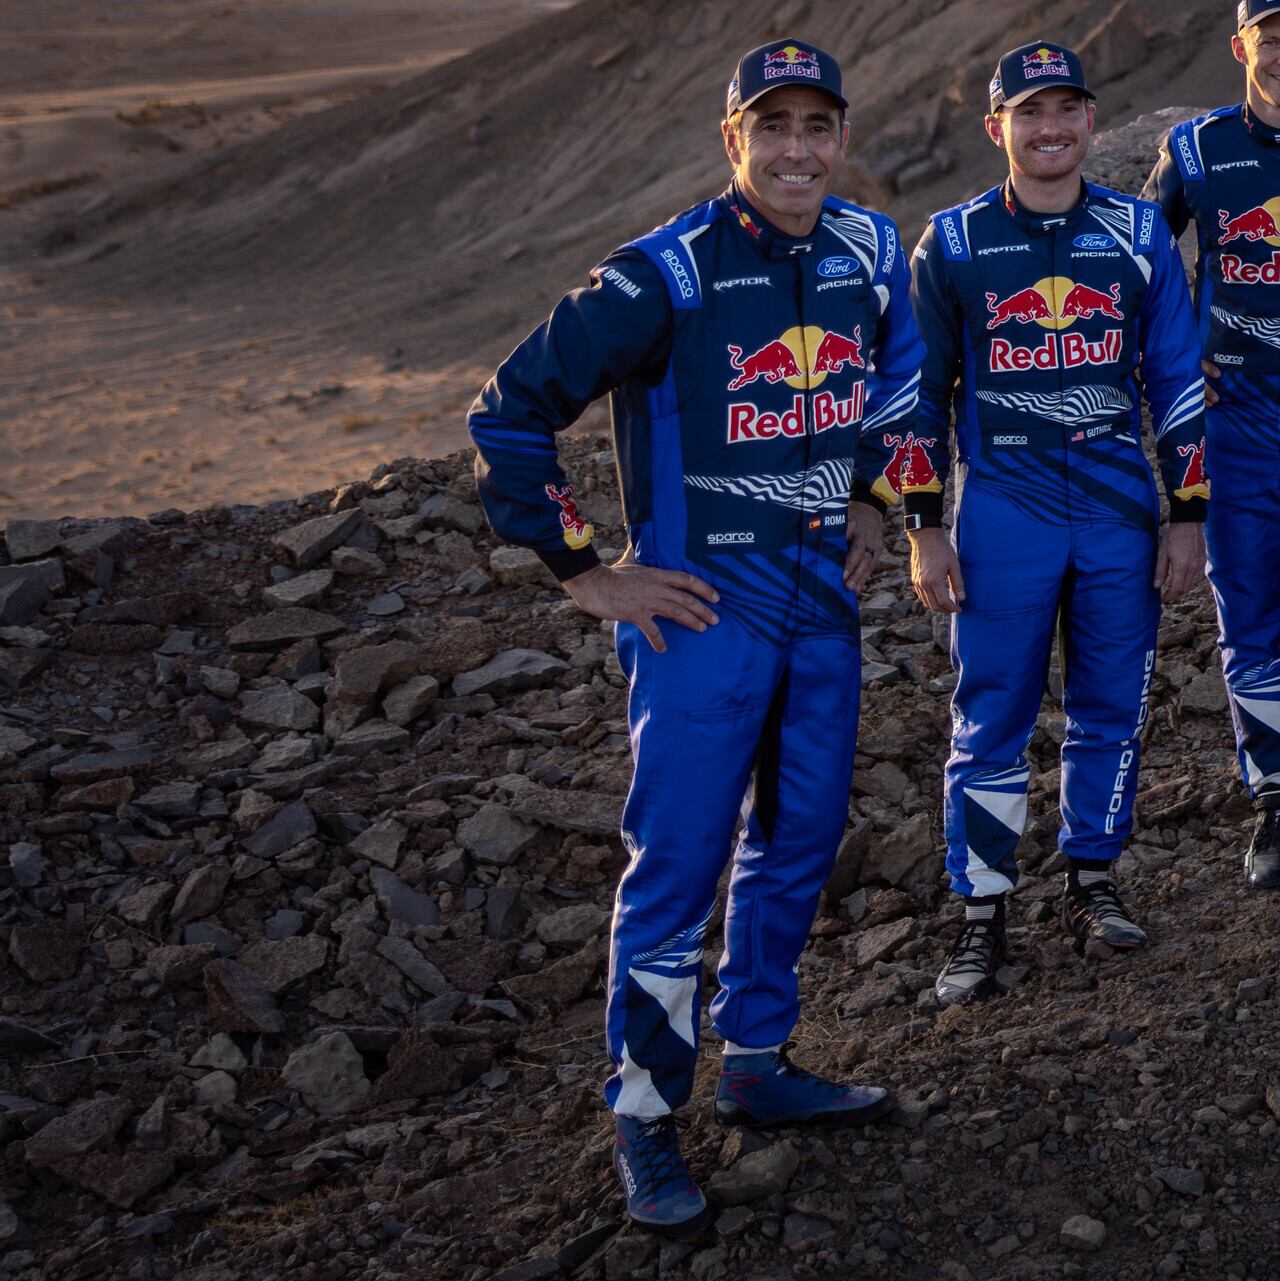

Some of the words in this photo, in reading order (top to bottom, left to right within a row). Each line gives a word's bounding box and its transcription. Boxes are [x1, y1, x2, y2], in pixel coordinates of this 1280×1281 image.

[764, 64, 793, 80] Red
[794, 64, 821, 79] Bull
[1024, 65, 1049, 79] Red
[1049, 64, 1071, 77] Bull
[1177, 135, 1198, 176] sparco
[1211, 160, 1263, 173] RAPTOR
[942, 216, 962, 255] sparco
[1139, 208, 1154, 246] sparco
[882, 226, 896, 275] sparco
[978, 244, 1032, 257] RAPTOR
[604, 269, 642, 299] OPTIMA
[660, 249, 694, 300] sparco
[713, 276, 775, 293] RAPTOR
[817, 278, 863, 293] RACING
[990, 333, 1059, 373] Red
[1061, 329, 1123, 369] Bull
[727, 394, 807, 445] Red
[813, 380, 865, 435] Bull
[993, 435, 1028, 445] sparco
[824, 514, 846, 527] ROMA
[707, 532, 754, 545] sparco
[1104, 749, 1134, 835] FORD
